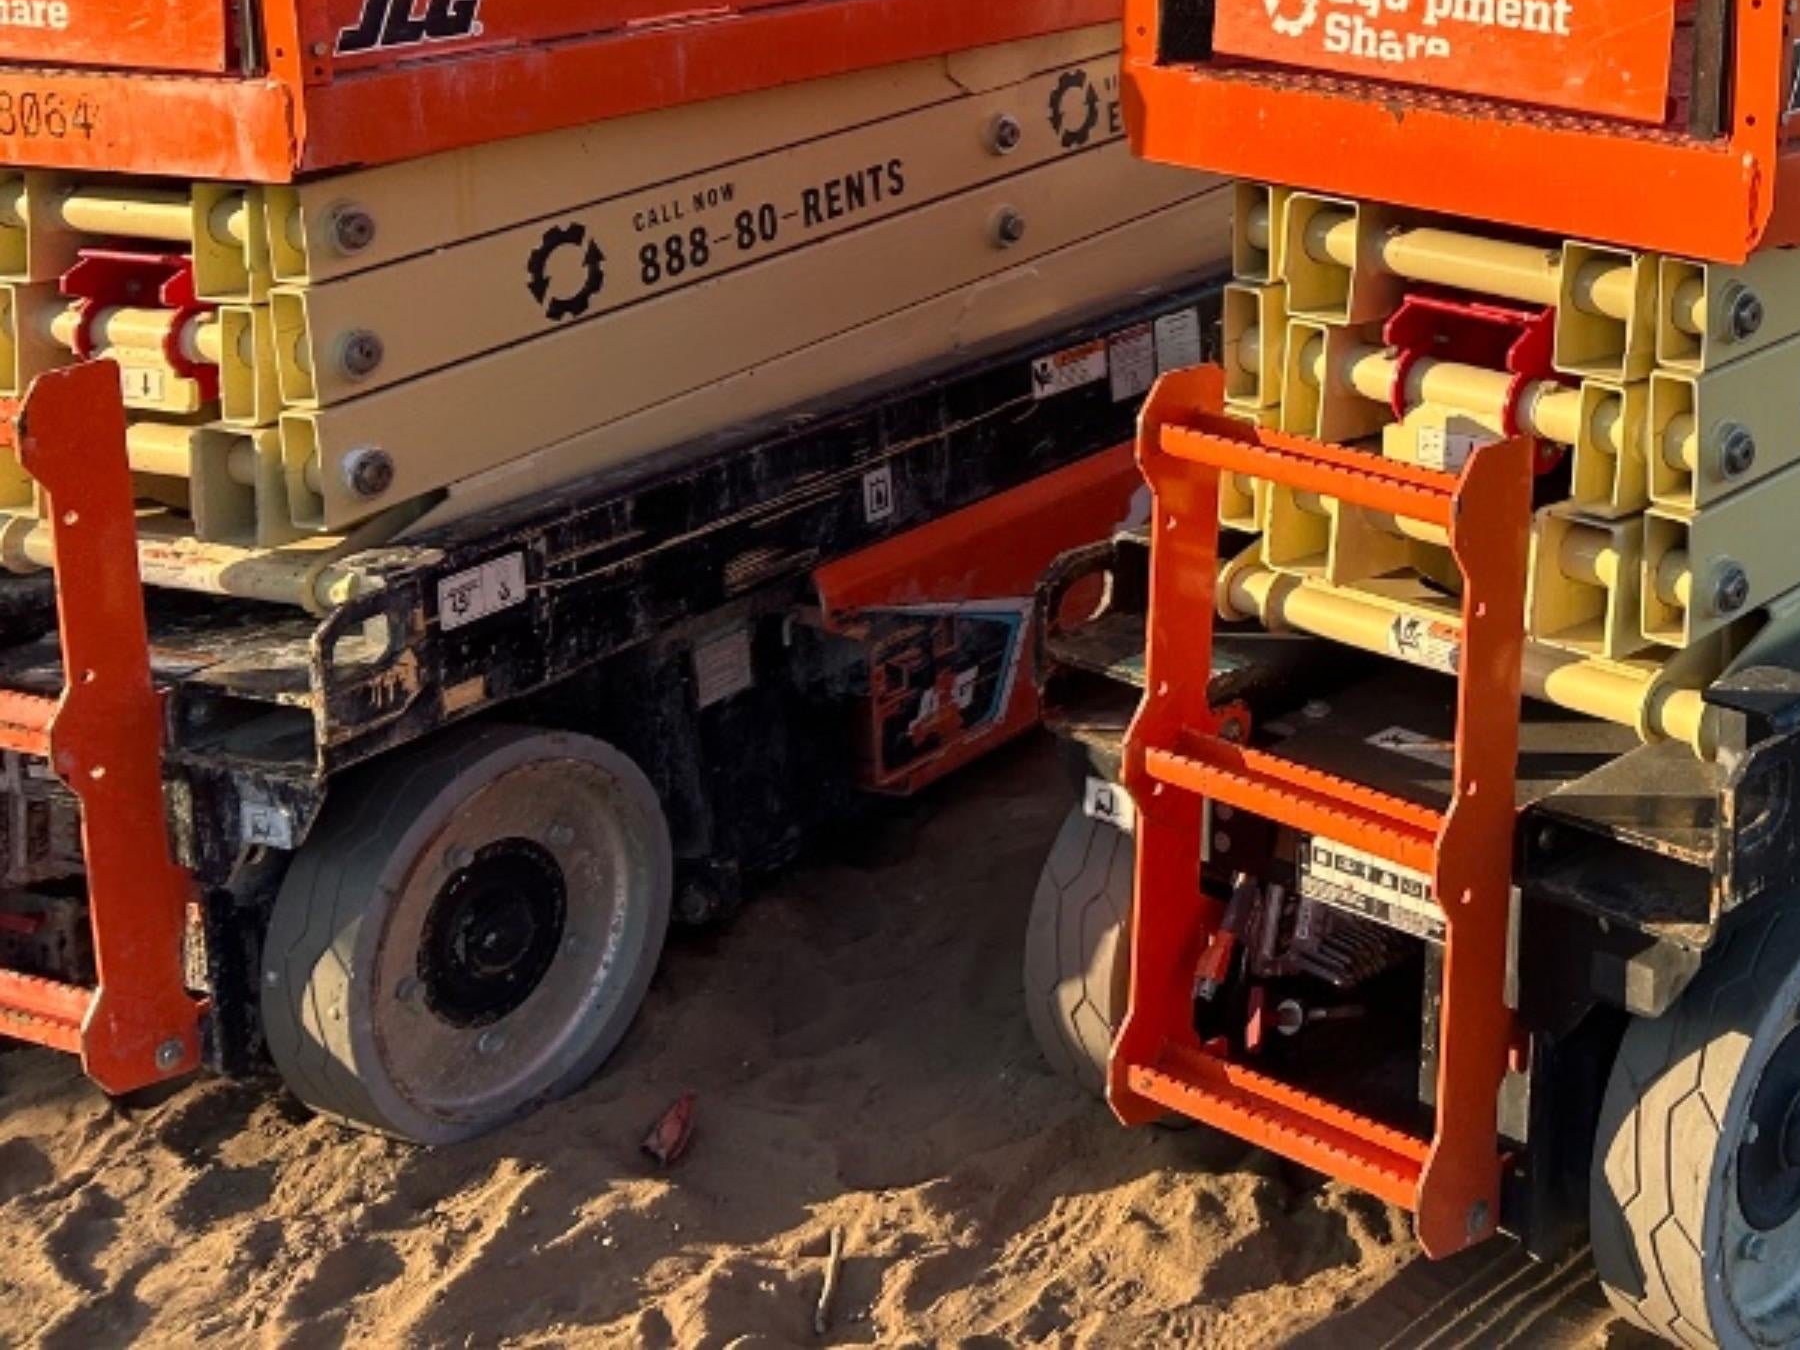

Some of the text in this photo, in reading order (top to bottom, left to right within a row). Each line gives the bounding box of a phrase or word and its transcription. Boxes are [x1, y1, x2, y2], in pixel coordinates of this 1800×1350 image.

[1324, 12, 1450, 64] Share
[633, 182, 735, 232] CALL NOW
[638, 158, 905, 285] 888-80-RENTS
